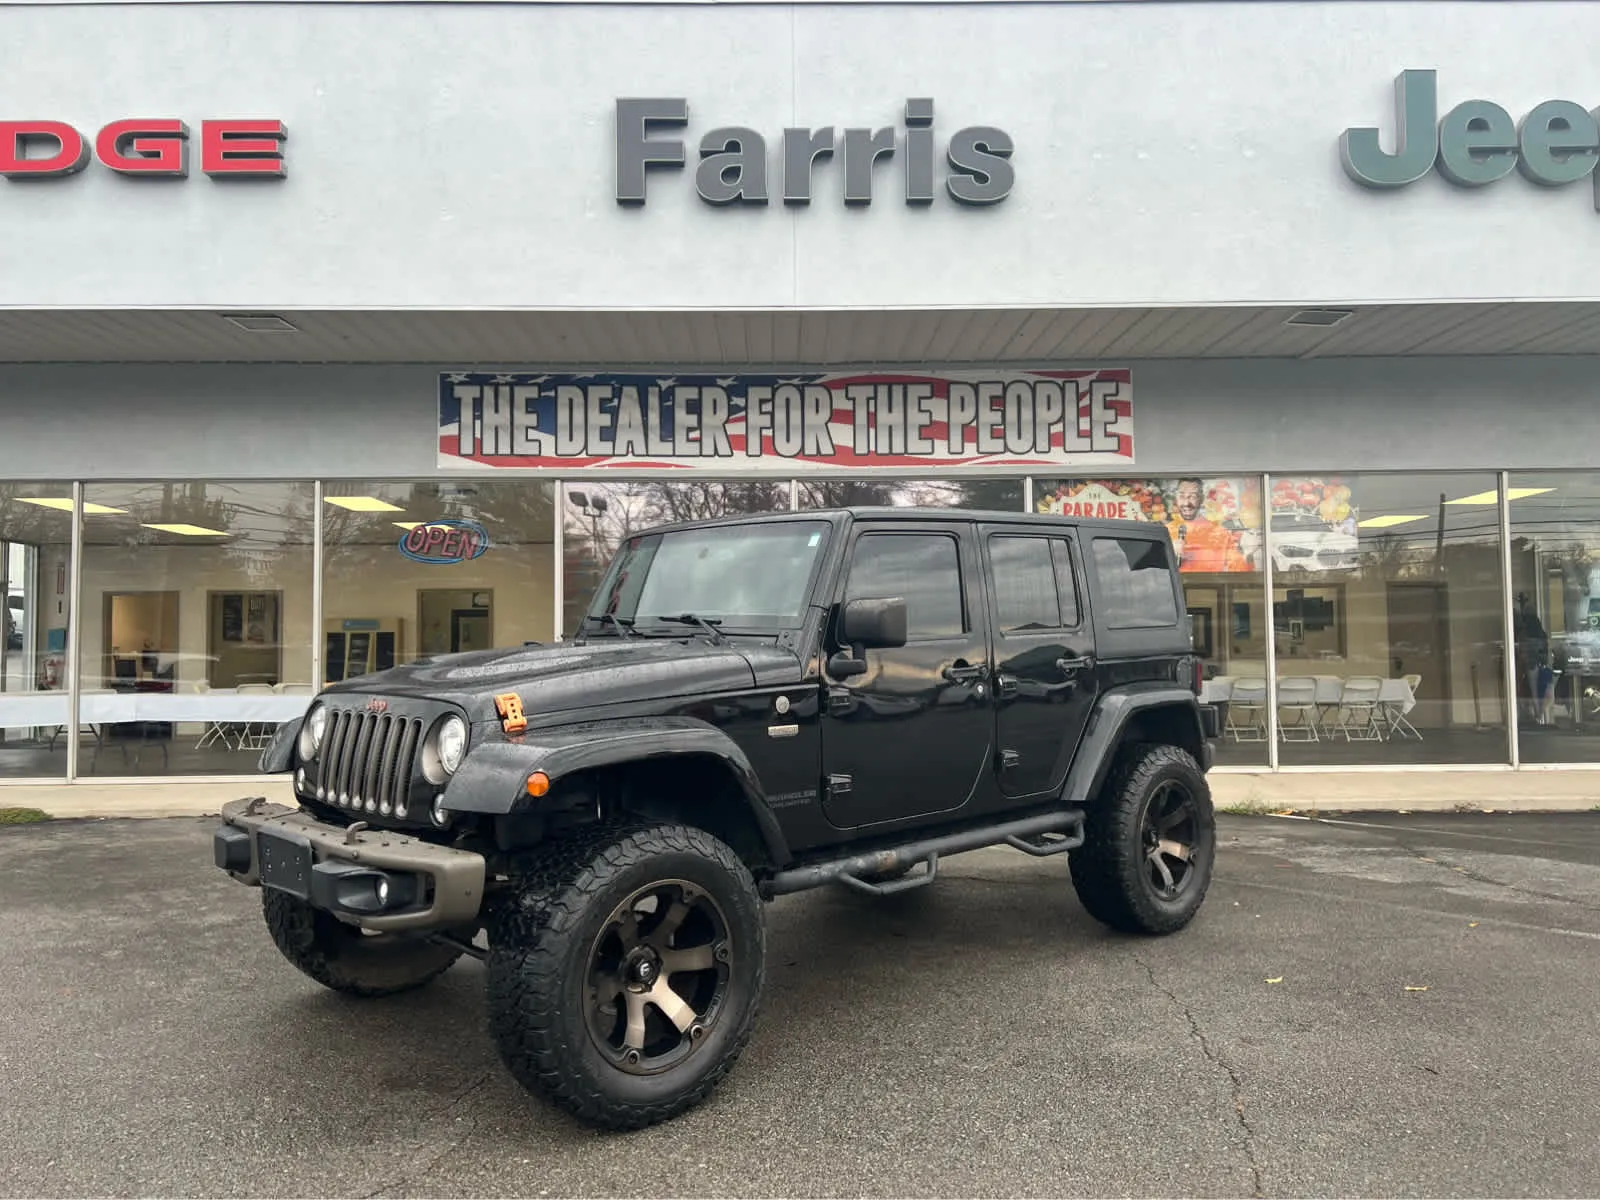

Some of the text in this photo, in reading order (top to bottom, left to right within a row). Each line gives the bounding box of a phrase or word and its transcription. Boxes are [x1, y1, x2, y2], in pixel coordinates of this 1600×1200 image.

[614, 97, 1016, 207] Farris
[1339, 69, 1600, 212] Jee
[452, 379, 1121, 458] THE DEALER FOR THE PEOPLE
[406, 524, 481, 561] OPEN
[1063, 501, 1129, 519] PARADE
